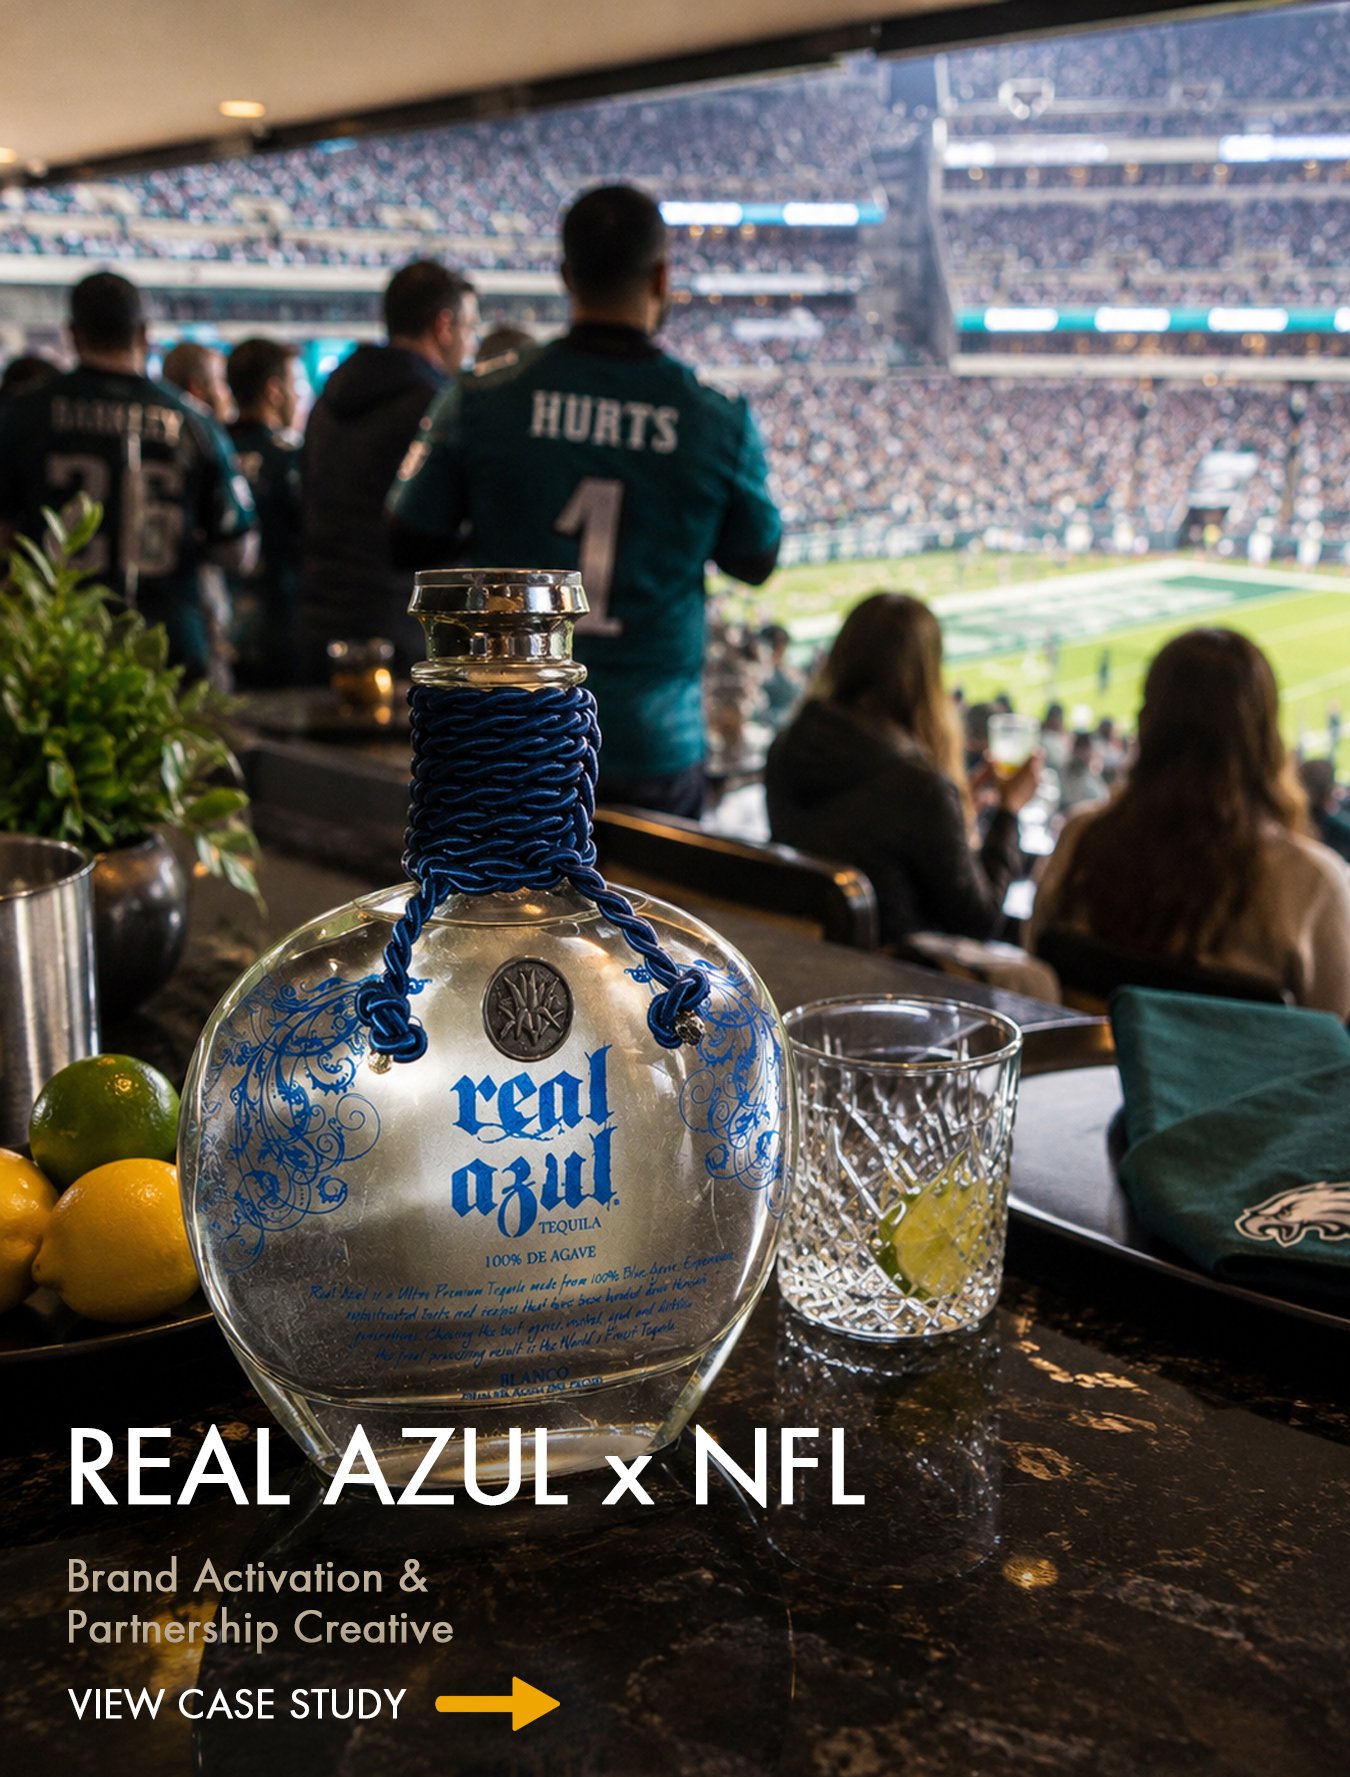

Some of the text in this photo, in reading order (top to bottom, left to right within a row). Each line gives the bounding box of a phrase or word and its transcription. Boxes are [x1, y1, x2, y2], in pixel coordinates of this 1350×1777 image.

[531, 390, 679, 455] HURTS
[46, 453, 183, 574] 26
[554, 476, 624, 636] 1
[450, 1041, 614, 1143] real
[538, 1216, 602, 1235] TEQUILA
[485, 1245, 596, 1268] 100% DE AGAVE
[559, 1273, 587, 1295] from
[591, 1270, 619, 1284] 100%
[499, 1366, 569, 1386] BLANCO
